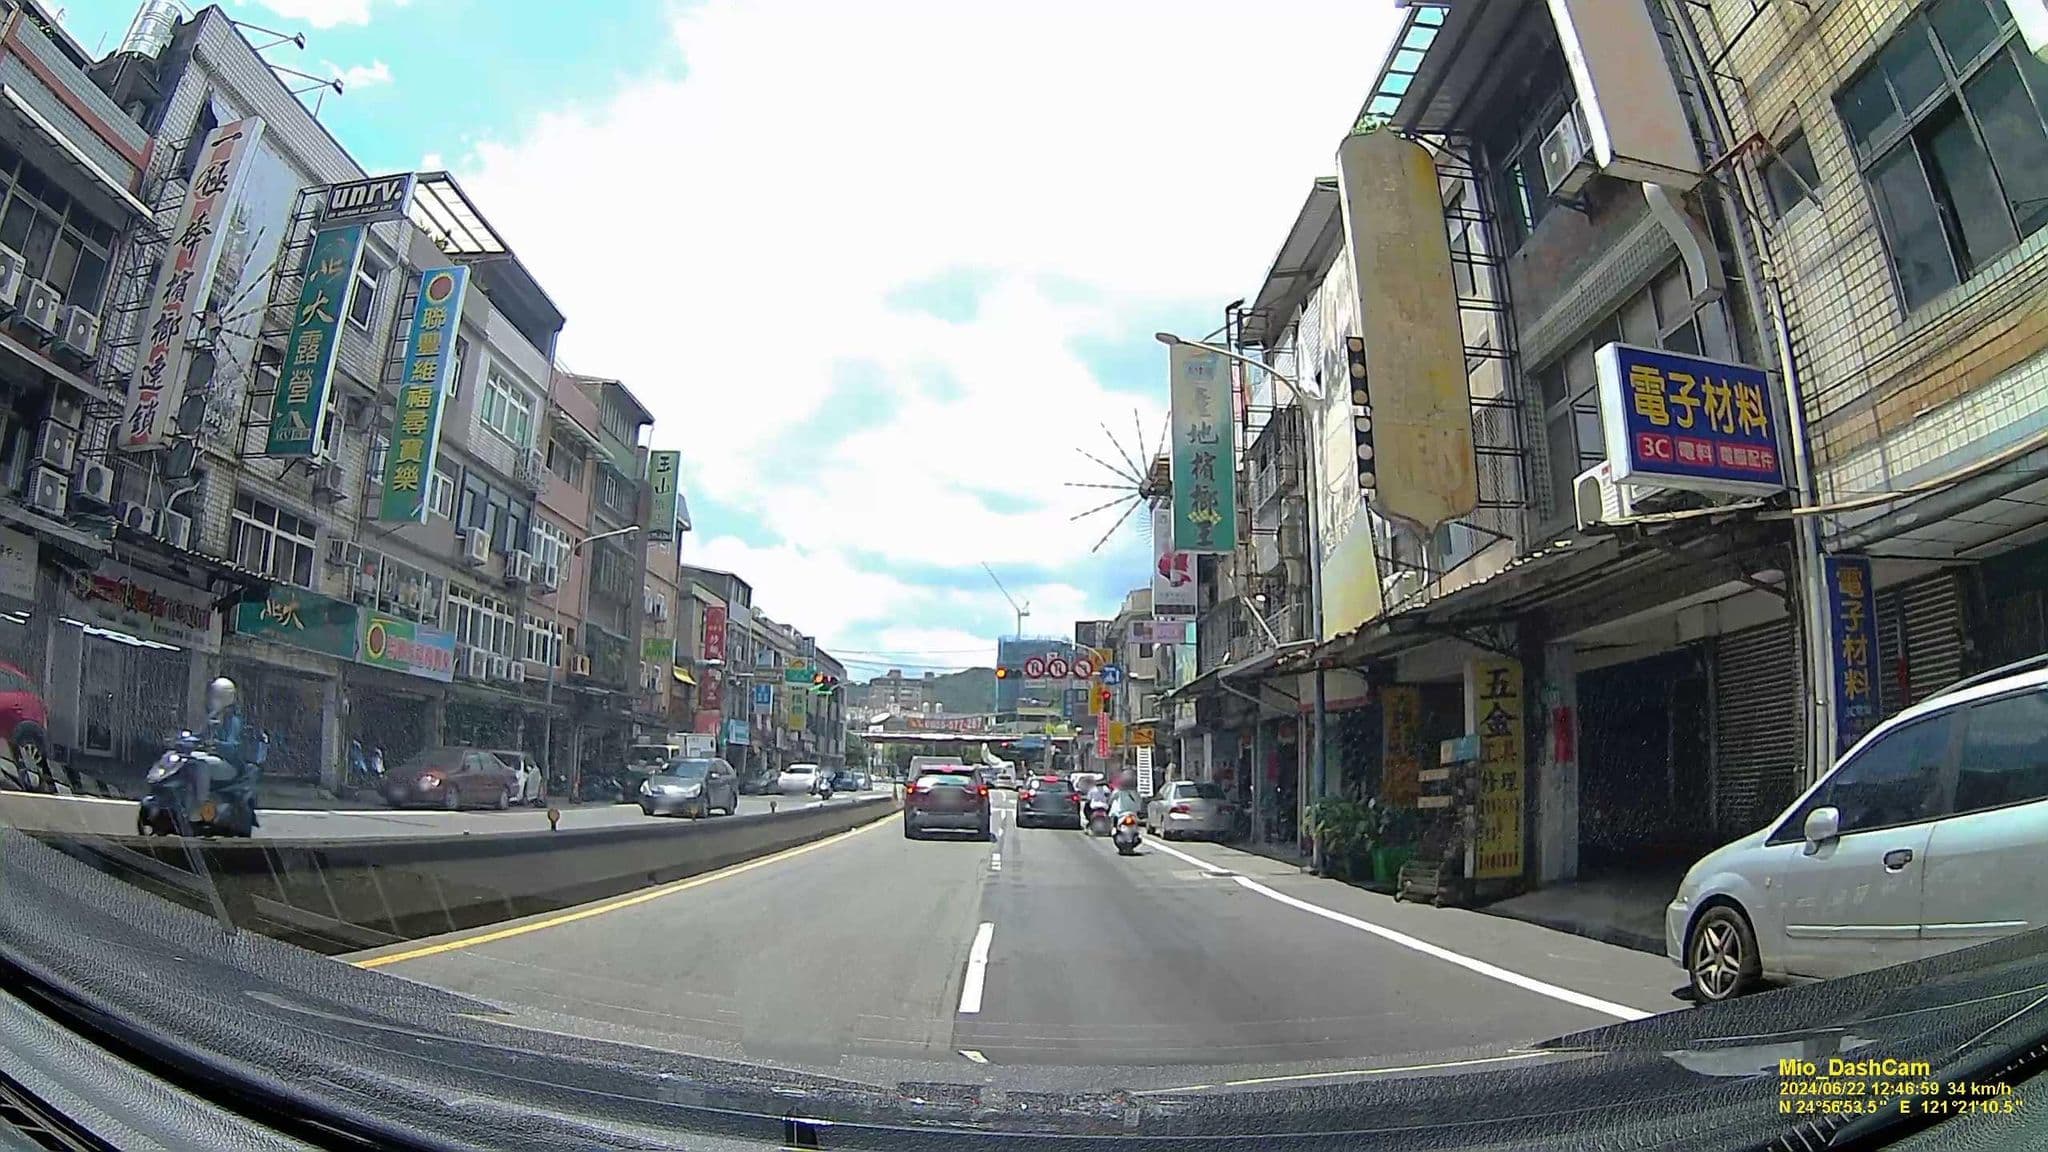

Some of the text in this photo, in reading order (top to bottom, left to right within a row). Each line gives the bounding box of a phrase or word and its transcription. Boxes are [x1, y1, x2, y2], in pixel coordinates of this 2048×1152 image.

[1629, 364, 1768, 440] 電子材料
[1641, 437, 1671, 459] 3C
[1837, 566, 1871, 701] 電子材料
[1479, 667, 1519, 738] 五金
